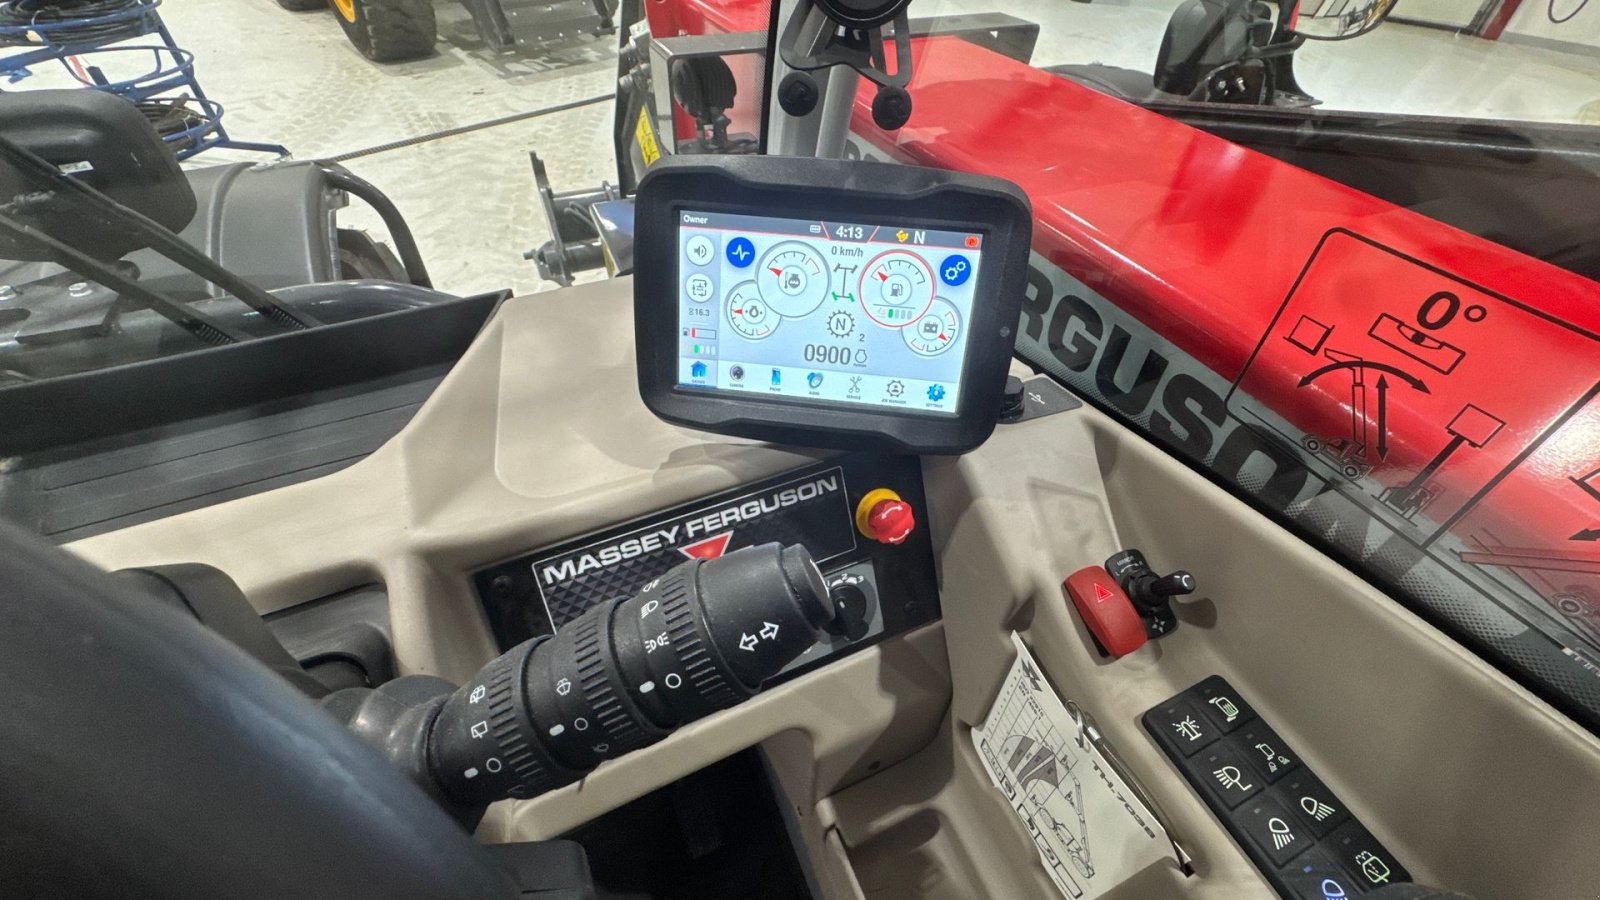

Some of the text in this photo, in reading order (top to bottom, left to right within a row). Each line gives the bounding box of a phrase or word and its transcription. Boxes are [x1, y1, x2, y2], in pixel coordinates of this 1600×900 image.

[683, 214, 708, 224] Owner
[835, 225, 863, 239] 4:13
[913, 230, 926, 244] N
[831, 246, 864, 257] 0 km/h
[1416, 290, 1488, 331] 0°
[835, 317, 847, 331] N
[859, 333, 865, 342] 2
[804, 343, 851, 365] 0900
[543, 476, 838, 584] MASSEY FERGUSON
[857, 575, 864, 583] 3
[1092, 760, 1156, 839] TH.7038
